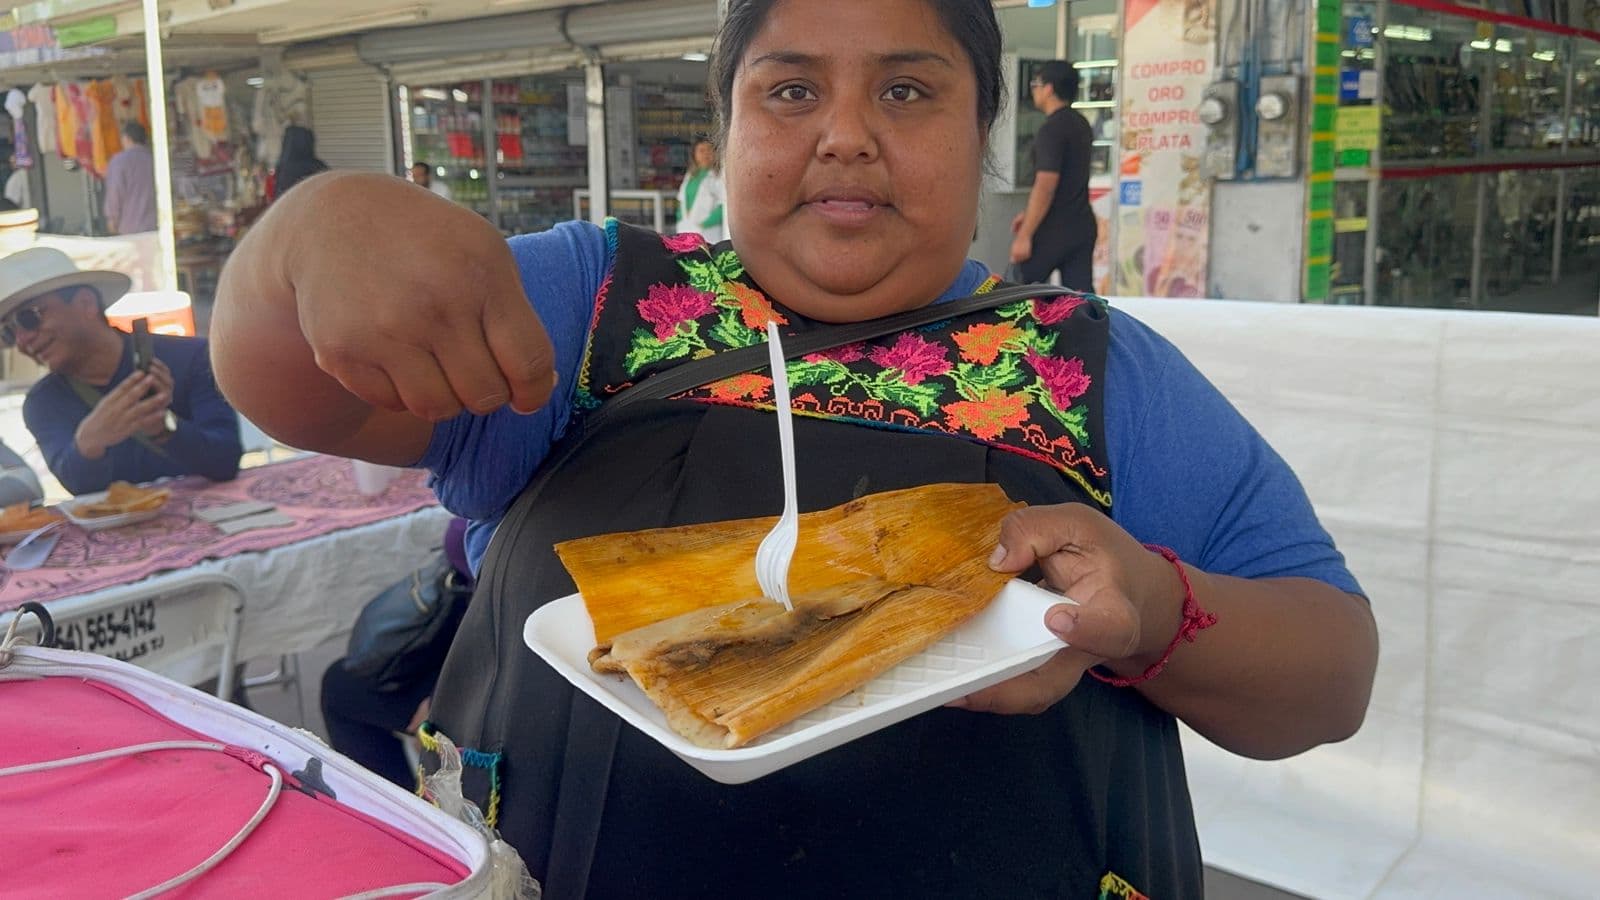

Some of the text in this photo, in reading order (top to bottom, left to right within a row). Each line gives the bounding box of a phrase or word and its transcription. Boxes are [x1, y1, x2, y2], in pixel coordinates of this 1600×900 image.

[1131, 60, 1206, 79] COMPRO
[1148, 86, 1184, 102] ORO
[1137, 134, 1192, 150] PLATA
